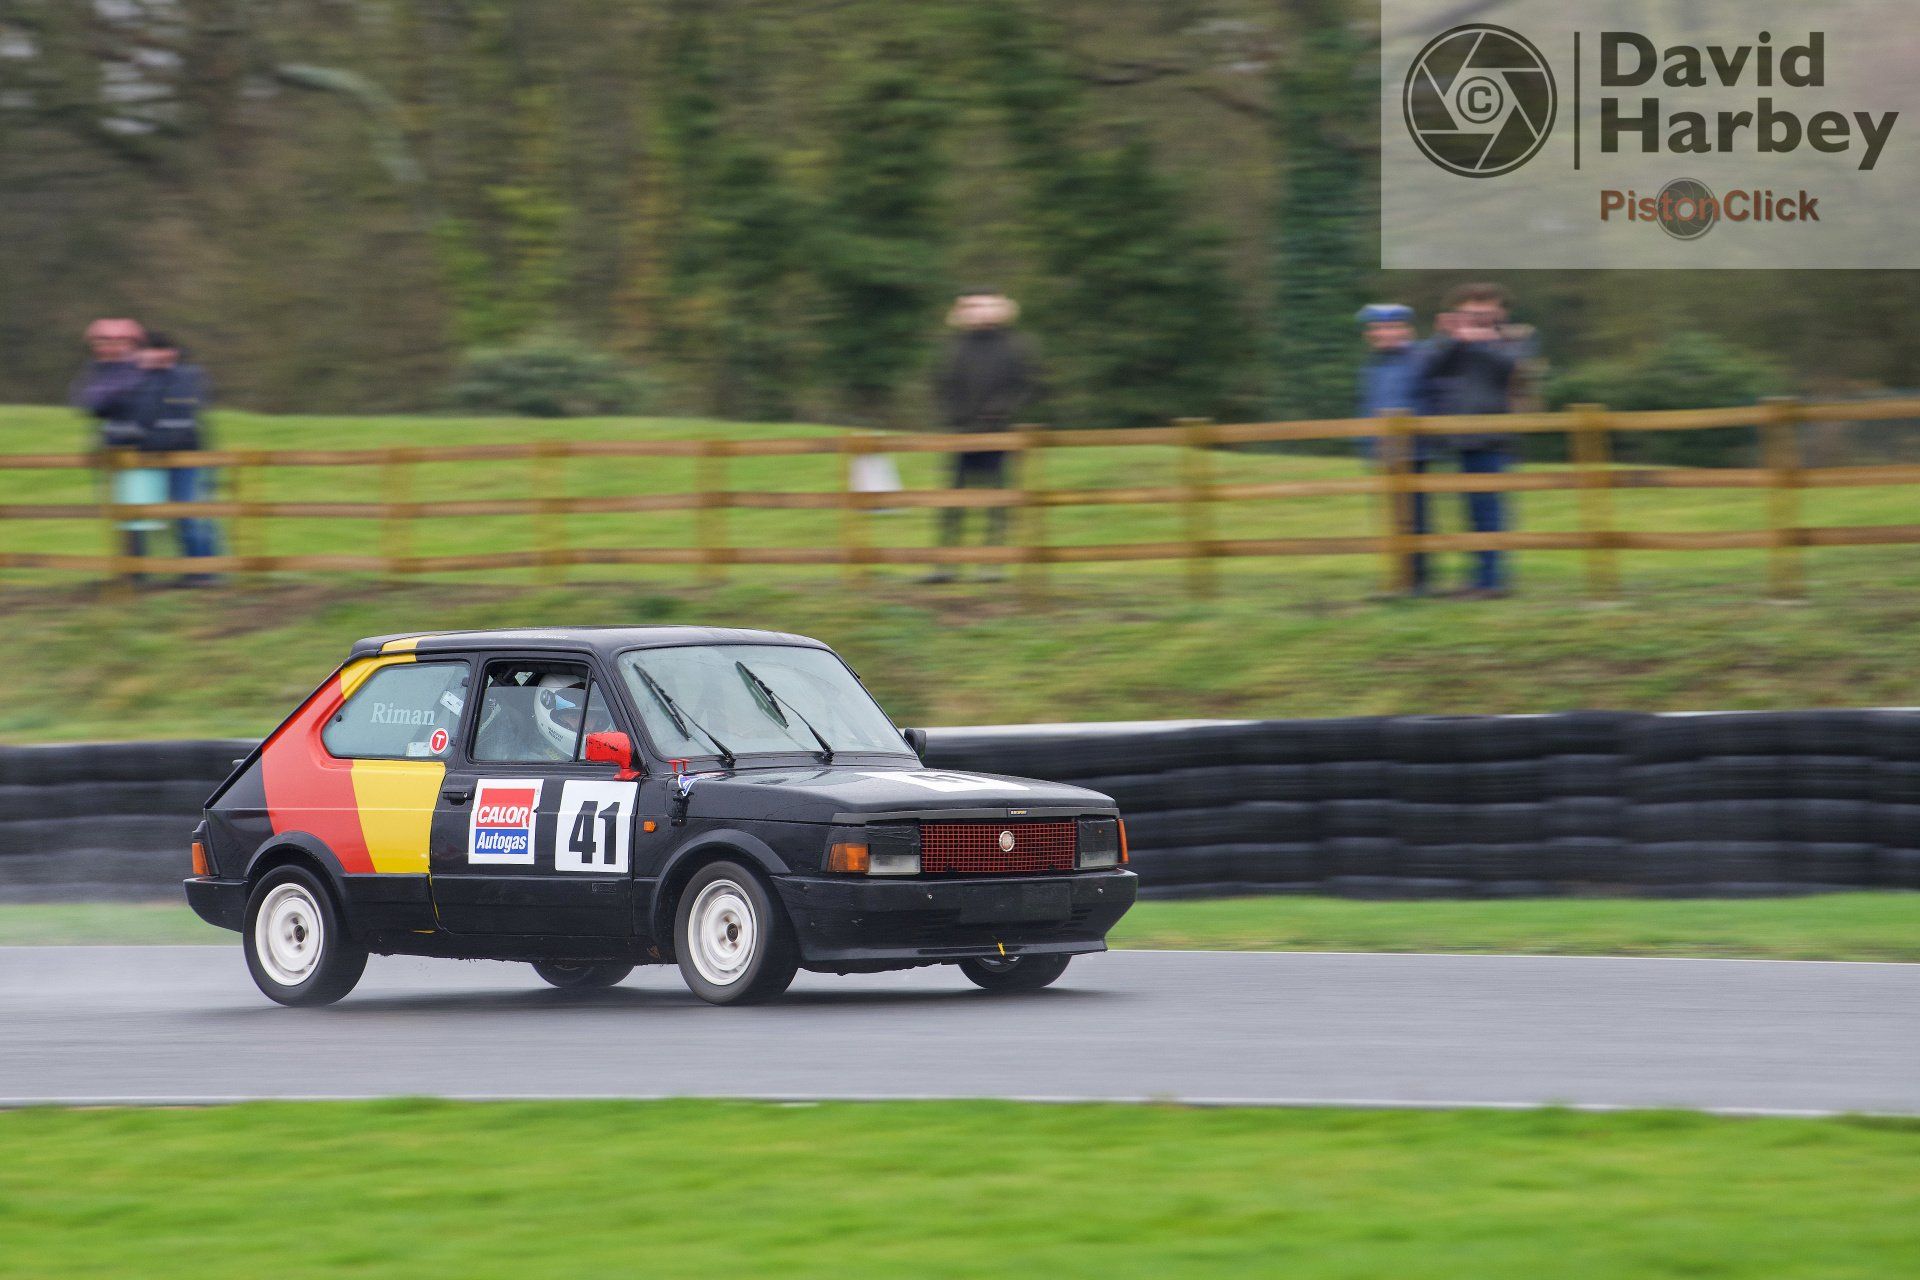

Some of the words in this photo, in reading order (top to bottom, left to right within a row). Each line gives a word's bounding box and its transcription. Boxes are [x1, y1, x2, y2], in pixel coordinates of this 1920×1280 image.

[370, 702, 435, 725] Riman
[435, 733, 446, 749] T
[477, 805, 529, 828] CALOR
[476, 831, 527, 853] Autogas
[568, 800, 621, 865] 41
